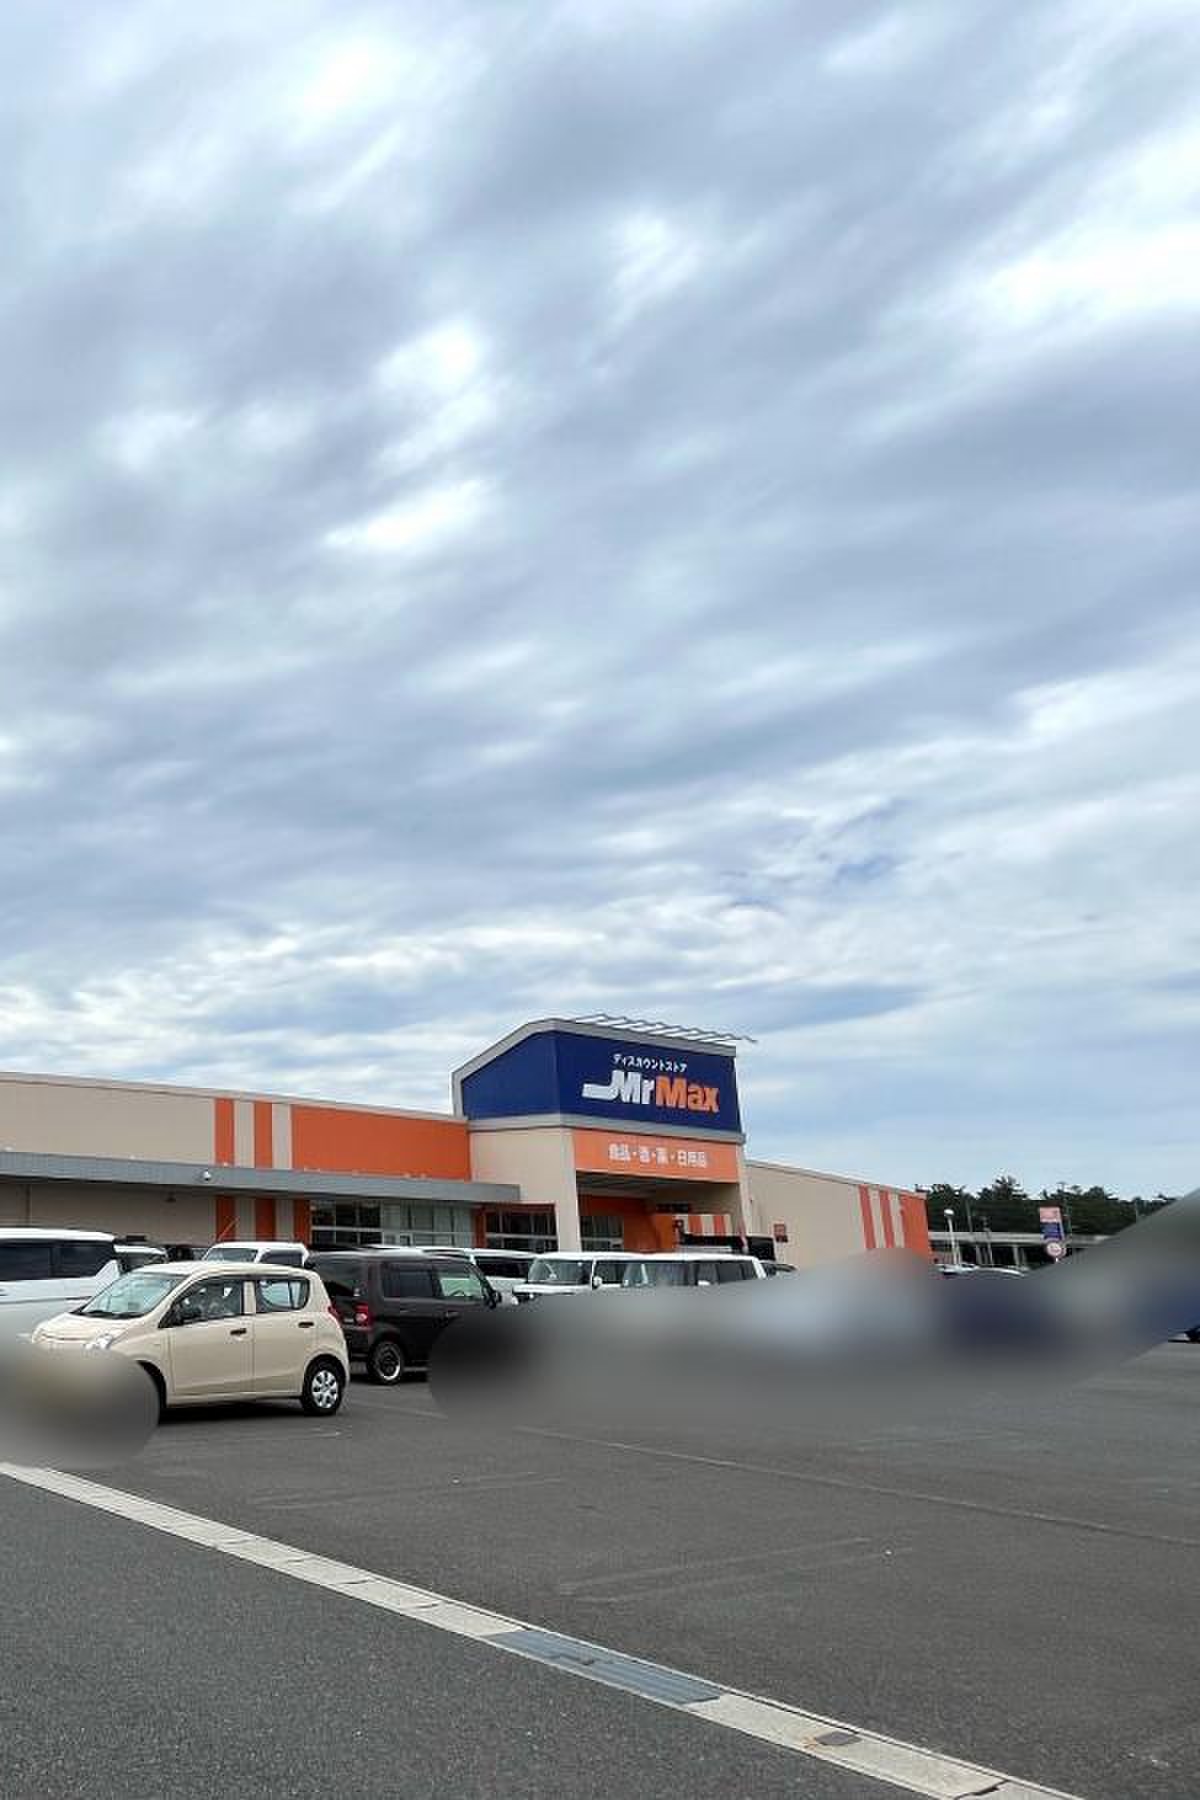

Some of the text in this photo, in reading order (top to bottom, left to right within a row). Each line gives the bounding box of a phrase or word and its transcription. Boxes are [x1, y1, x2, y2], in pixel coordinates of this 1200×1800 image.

[612, 1053, 688, 1073] ディスカウントストア
